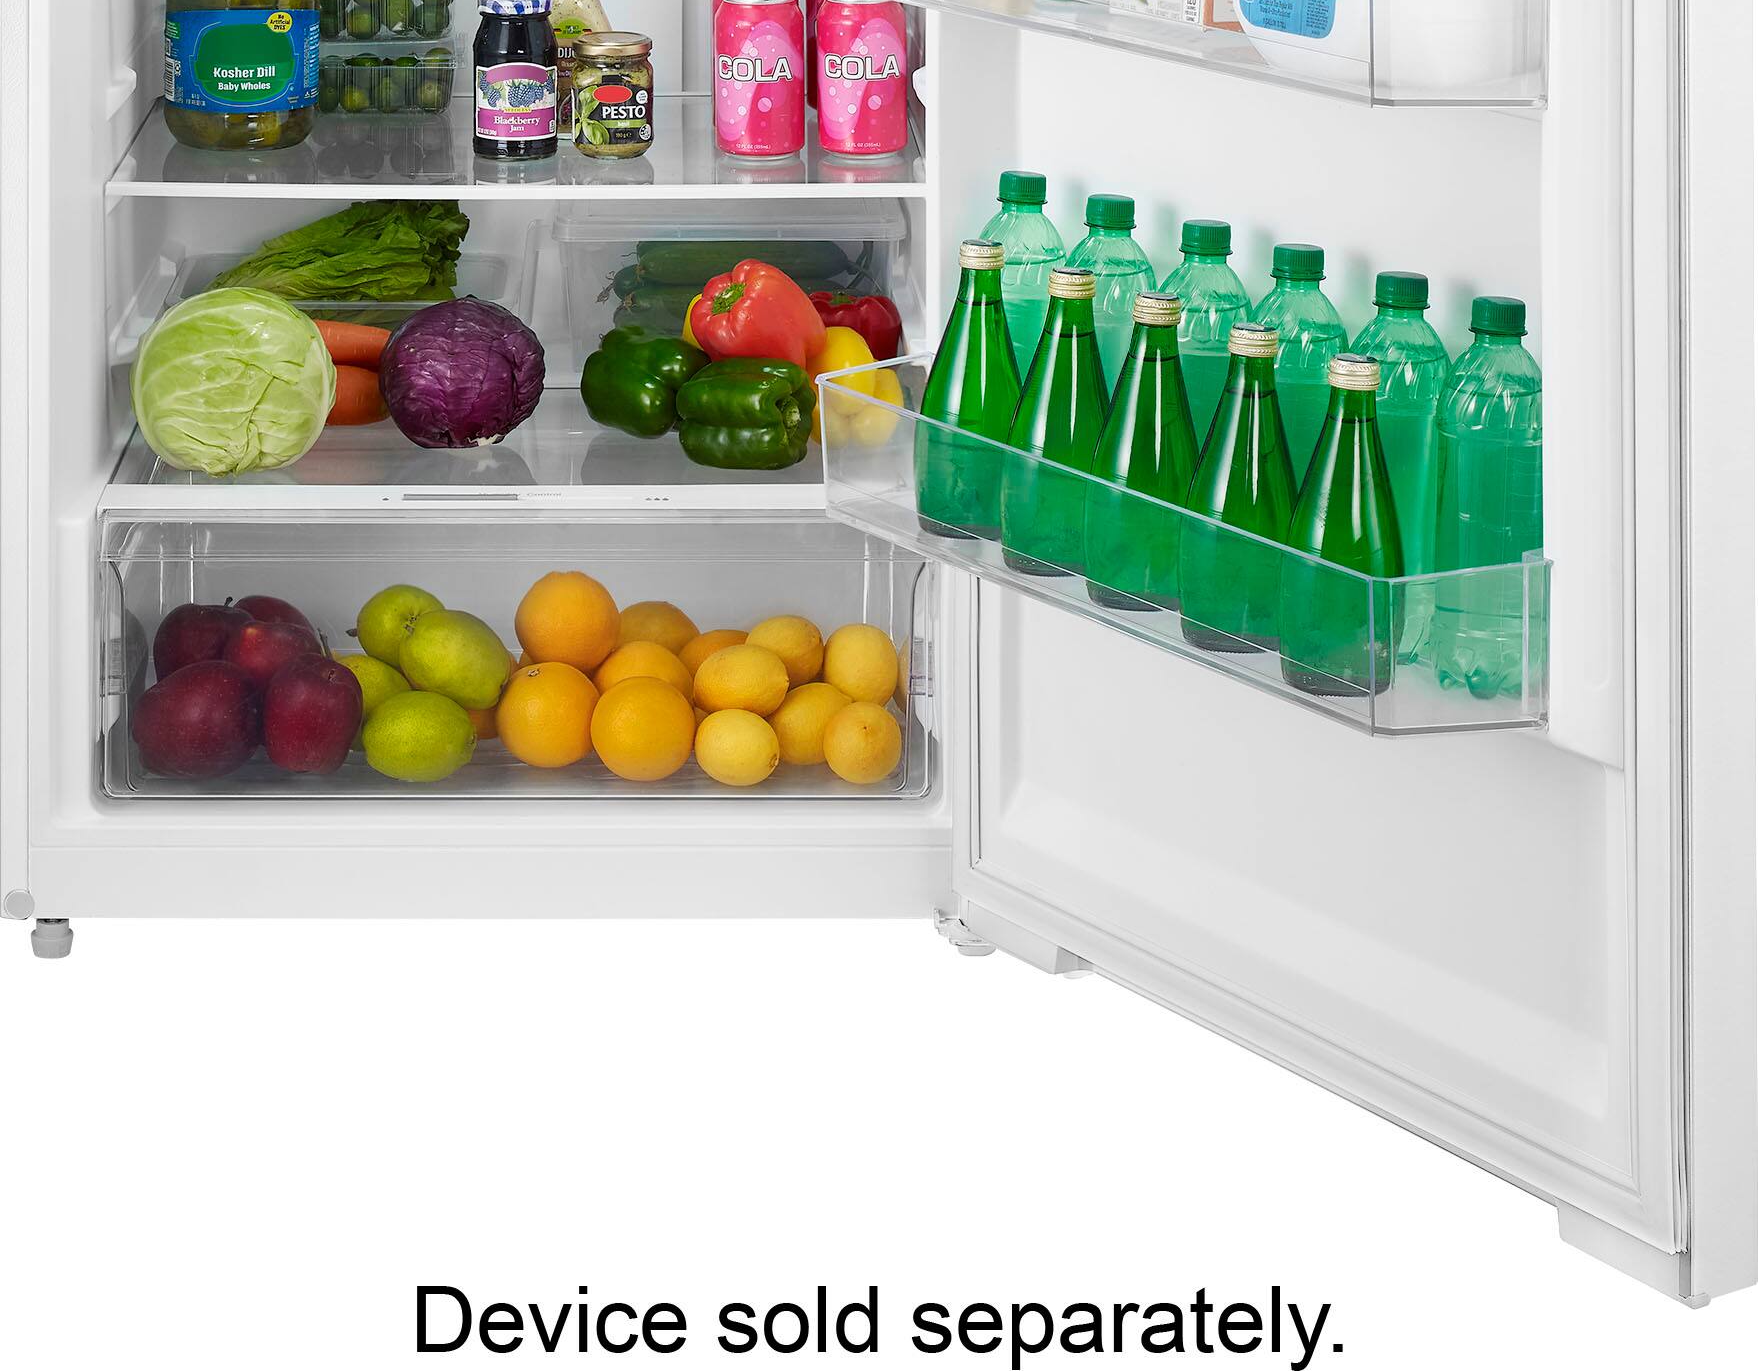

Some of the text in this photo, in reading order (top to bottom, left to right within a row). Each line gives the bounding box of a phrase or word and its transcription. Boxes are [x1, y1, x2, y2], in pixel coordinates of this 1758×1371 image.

[213, 66, 276, 78] Kosher Dill
[718, 54, 793, 82] COLA
[824, 53, 900, 81] COLA
[218, 82, 271, 92] Baby Wholes
[602, 105, 646, 119] PESTO
[494, 115, 541, 126] Blackberry
